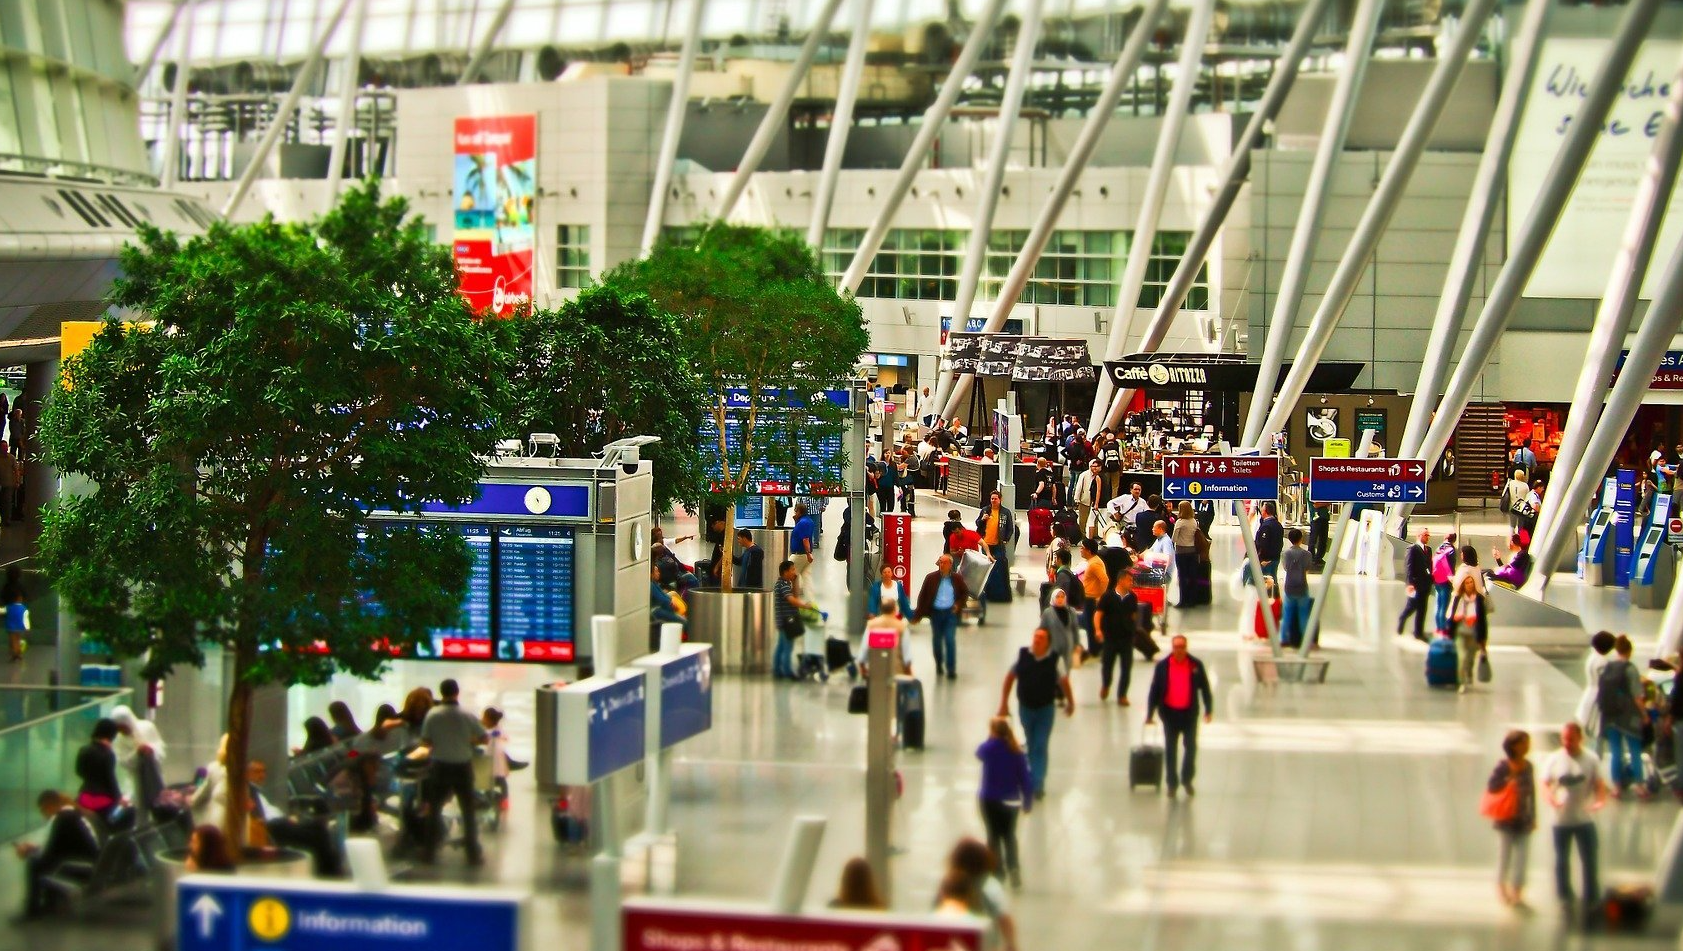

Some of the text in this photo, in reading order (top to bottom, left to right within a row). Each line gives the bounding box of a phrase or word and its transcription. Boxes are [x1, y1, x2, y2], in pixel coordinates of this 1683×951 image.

[1114, 366, 1149, 380] Caffè
[1346, 465, 1386, 473] Restaurants
[1204, 484, 1248, 492] Information
[1356, 490, 1385, 498] Customs
[298, 910, 428, 937] Information
